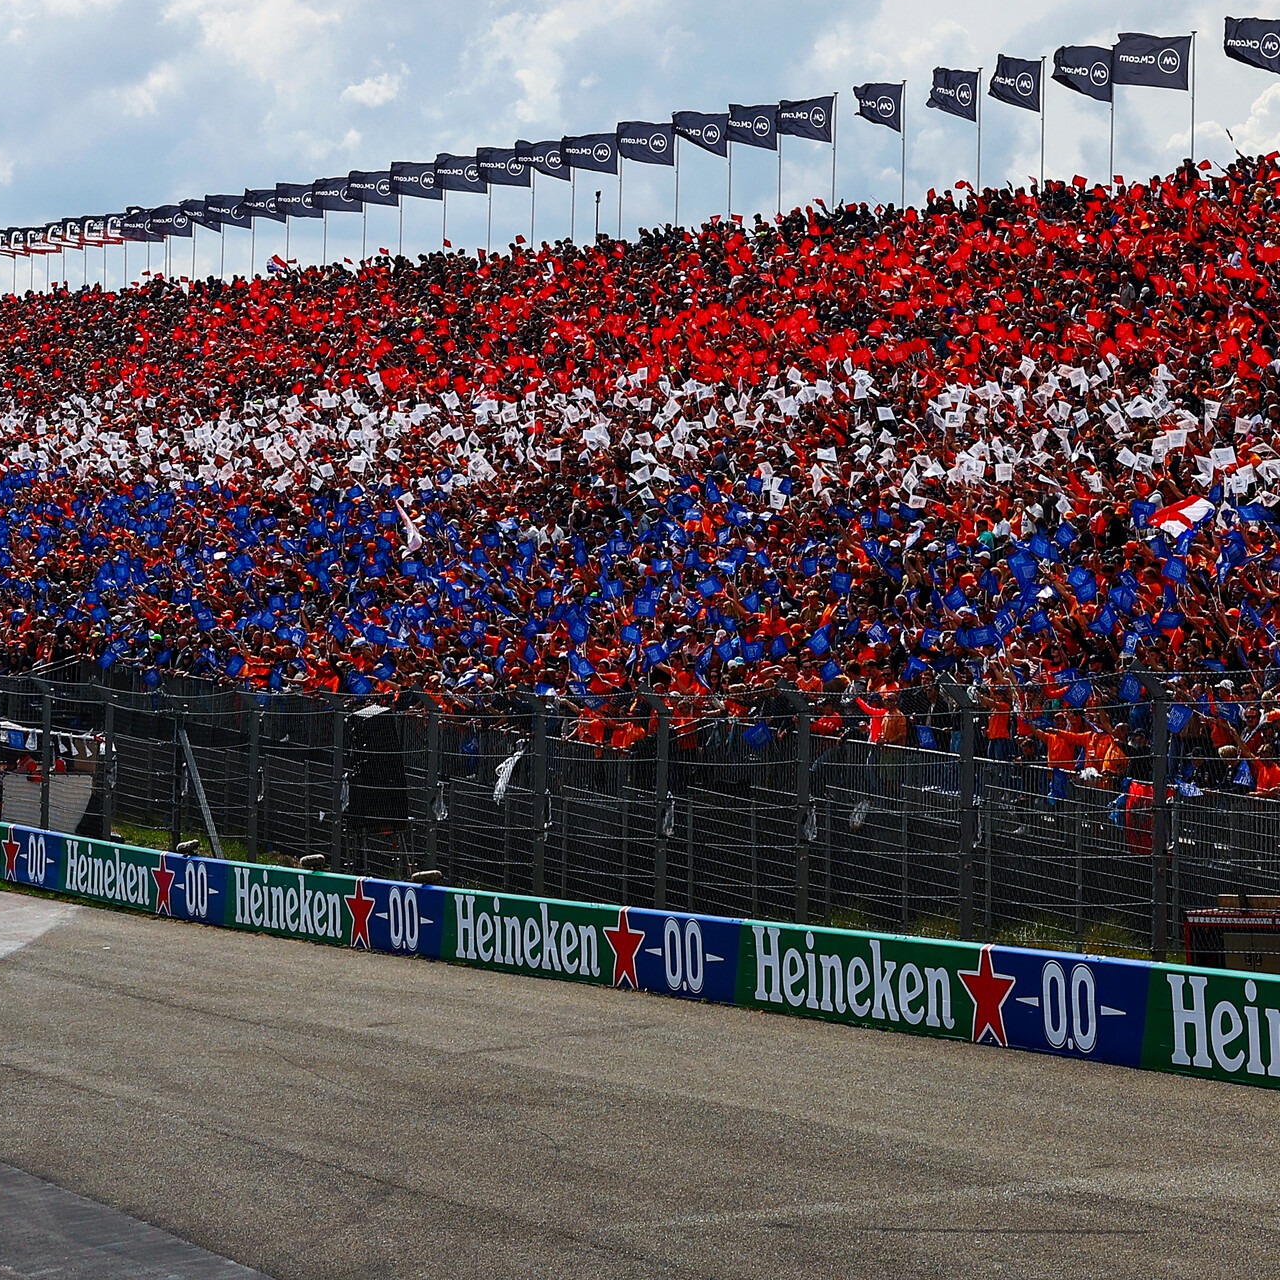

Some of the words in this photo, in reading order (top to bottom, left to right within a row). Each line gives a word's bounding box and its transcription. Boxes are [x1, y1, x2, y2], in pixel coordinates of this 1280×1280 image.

[27, 832, 46, 885] 0.0
[65, 839, 150, 906] Heineken
[184, 860, 209, 918] 0.0
[234, 867, 343, 938] Heineken
[388, 885, 420, 951] 0.0
[454, 894, 601, 977] Heineken
[662, 916, 705, 993] 0.0
[752, 926, 955, 1030] Heineken
[1041, 960, 1098, 1053] 0.0
